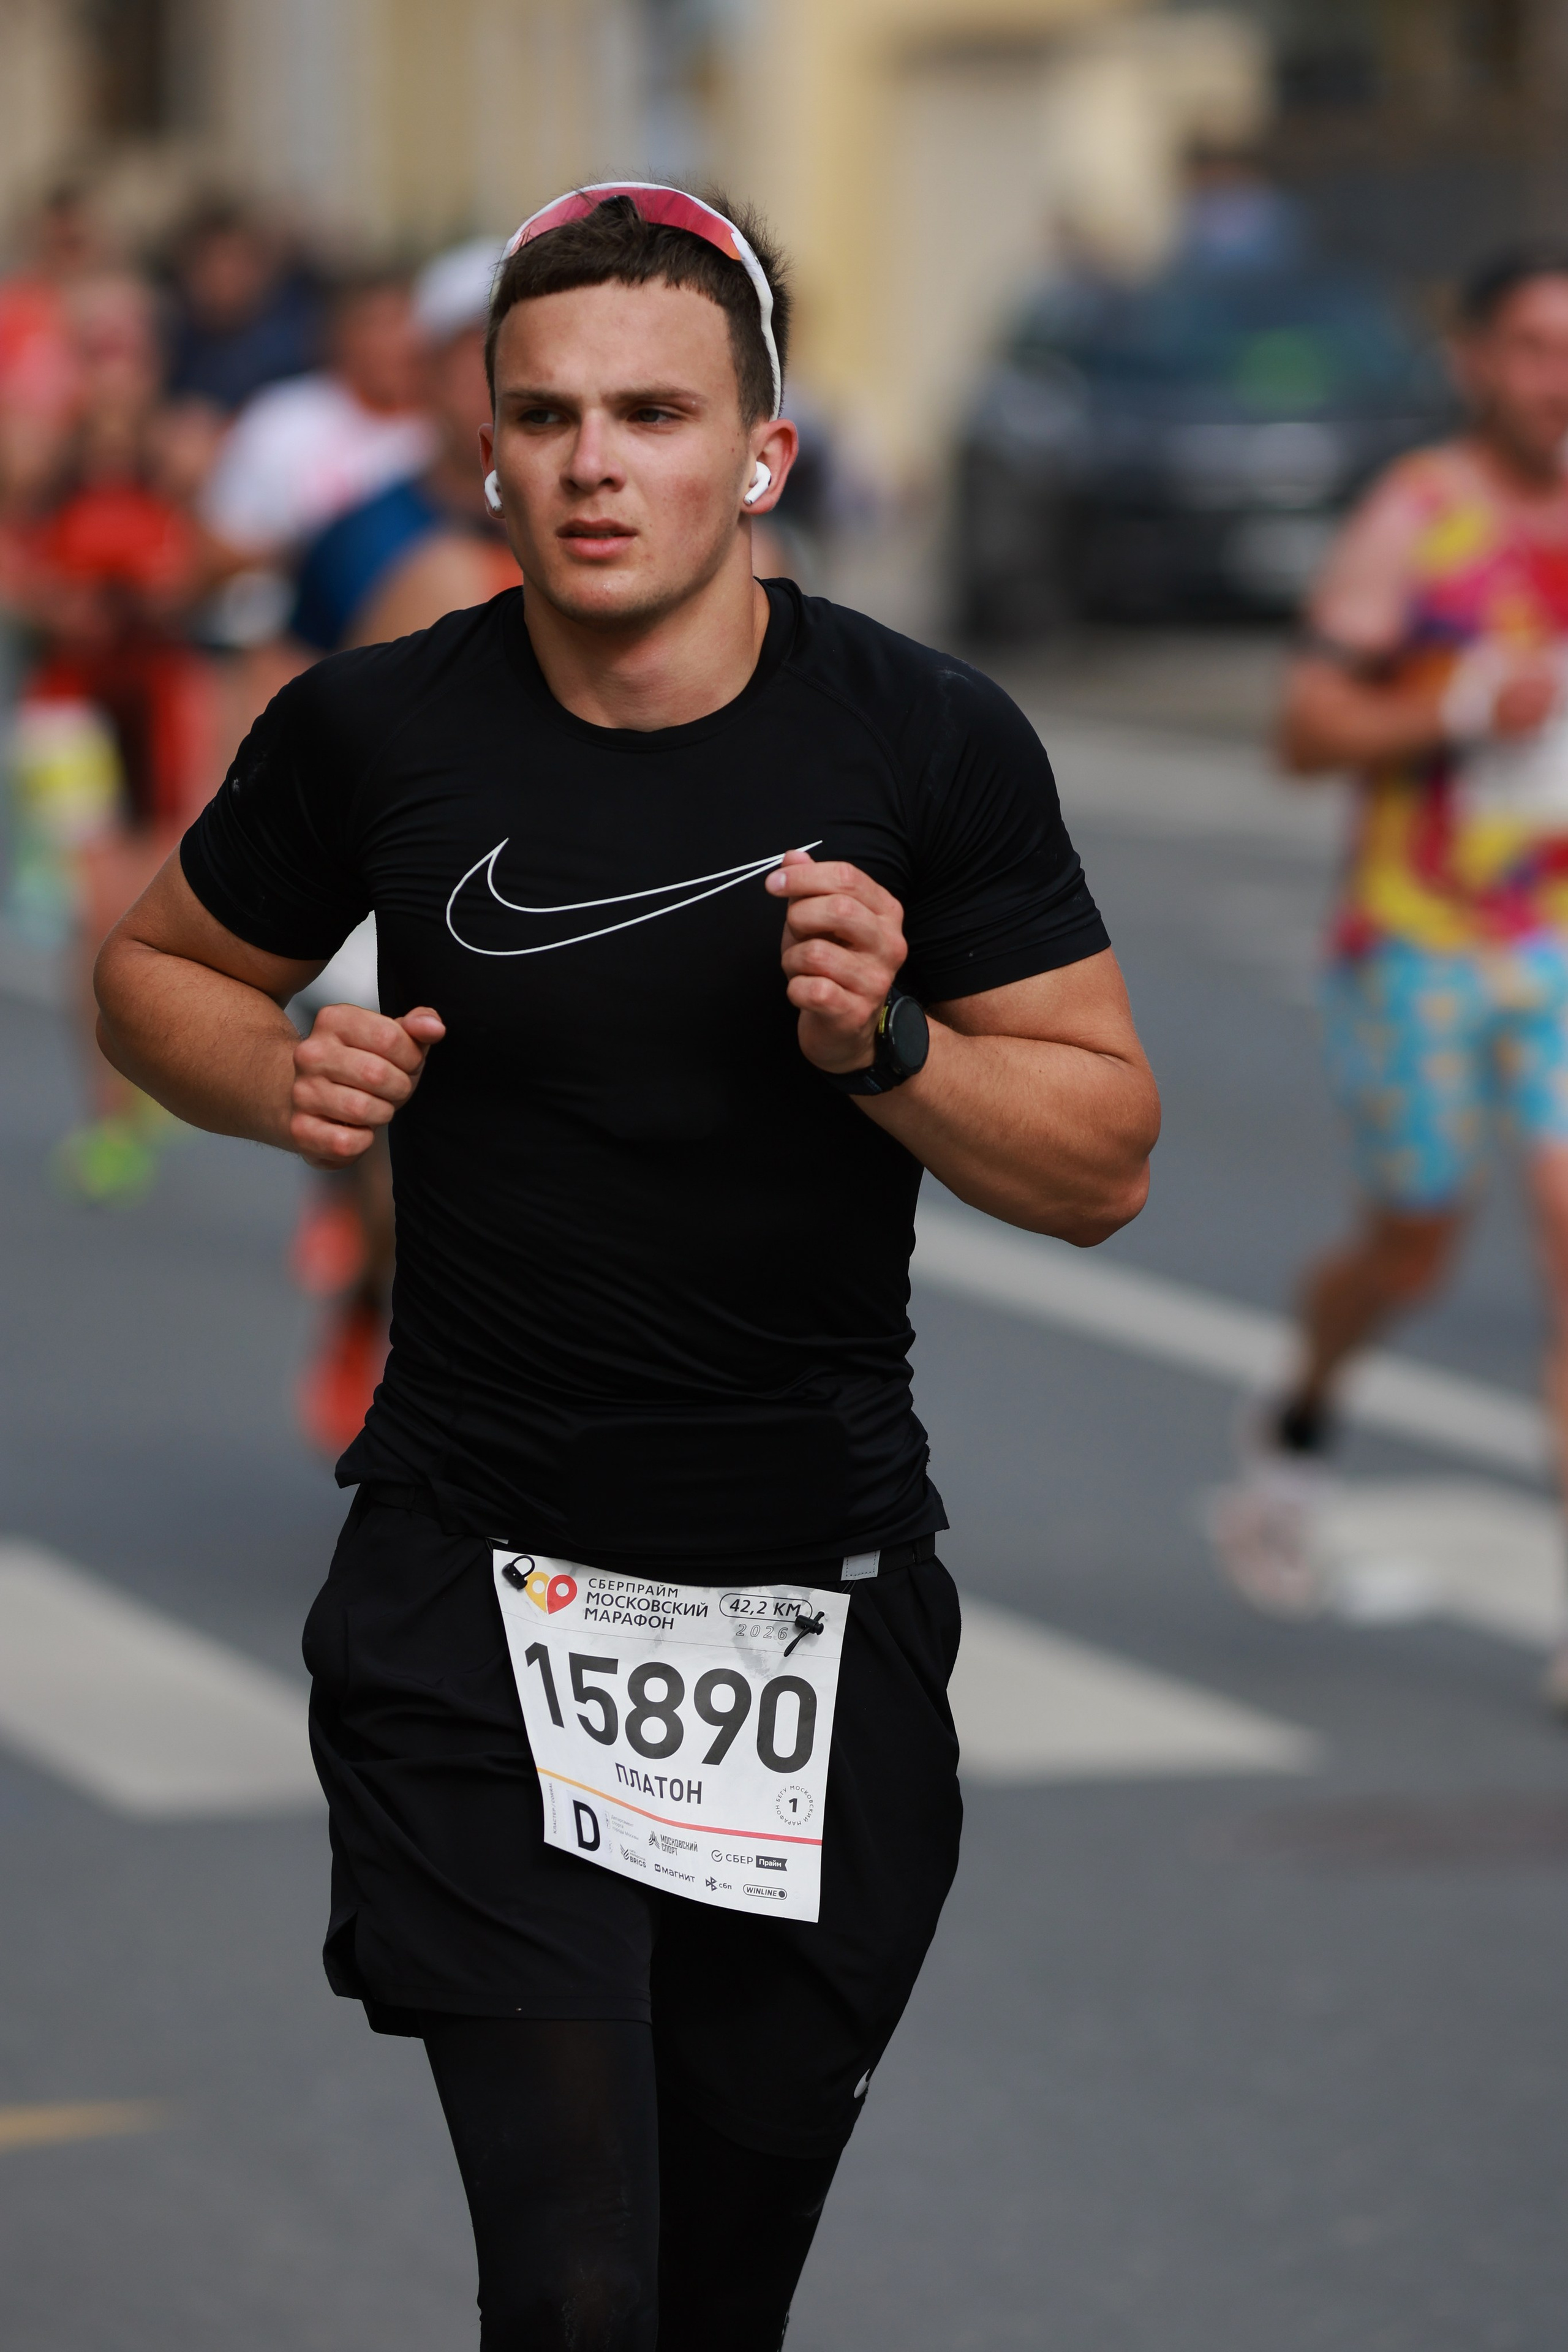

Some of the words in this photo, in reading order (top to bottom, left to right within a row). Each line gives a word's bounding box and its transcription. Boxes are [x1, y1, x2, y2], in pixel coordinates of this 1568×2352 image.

[589, 1578, 679, 1598] СБЕРПРАЙМ
[586, 1591, 709, 1618] МОСКОВСКИЙ
[729, 1599, 767, 1616] 42,2
[584, 1607, 674, 1630] МАРАФОН
[736, 1624, 788, 1640] 2026
[524, 1642, 817, 1773] 15890
[615, 1762, 703, 1804] ПЛАТОН
[775, 1788, 786, 1802] БЕГУ
[788, 1798, 797, 1813] 1
[775, 1804, 802, 1826] МАРАФОН
[573, 1800, 601, 1852] D
[660, 1834, 698, 1852] МОСКОВСКИЙ
[662, 1842, 678, 1855] СПОРТ
[630, 1856, 647, 1868] BRICS
[726, 1854, 753, 1864] СБЕР
[759, 1858, 782, 1868] Прайм
[747, 1887, 777, 1897] WINLINE
